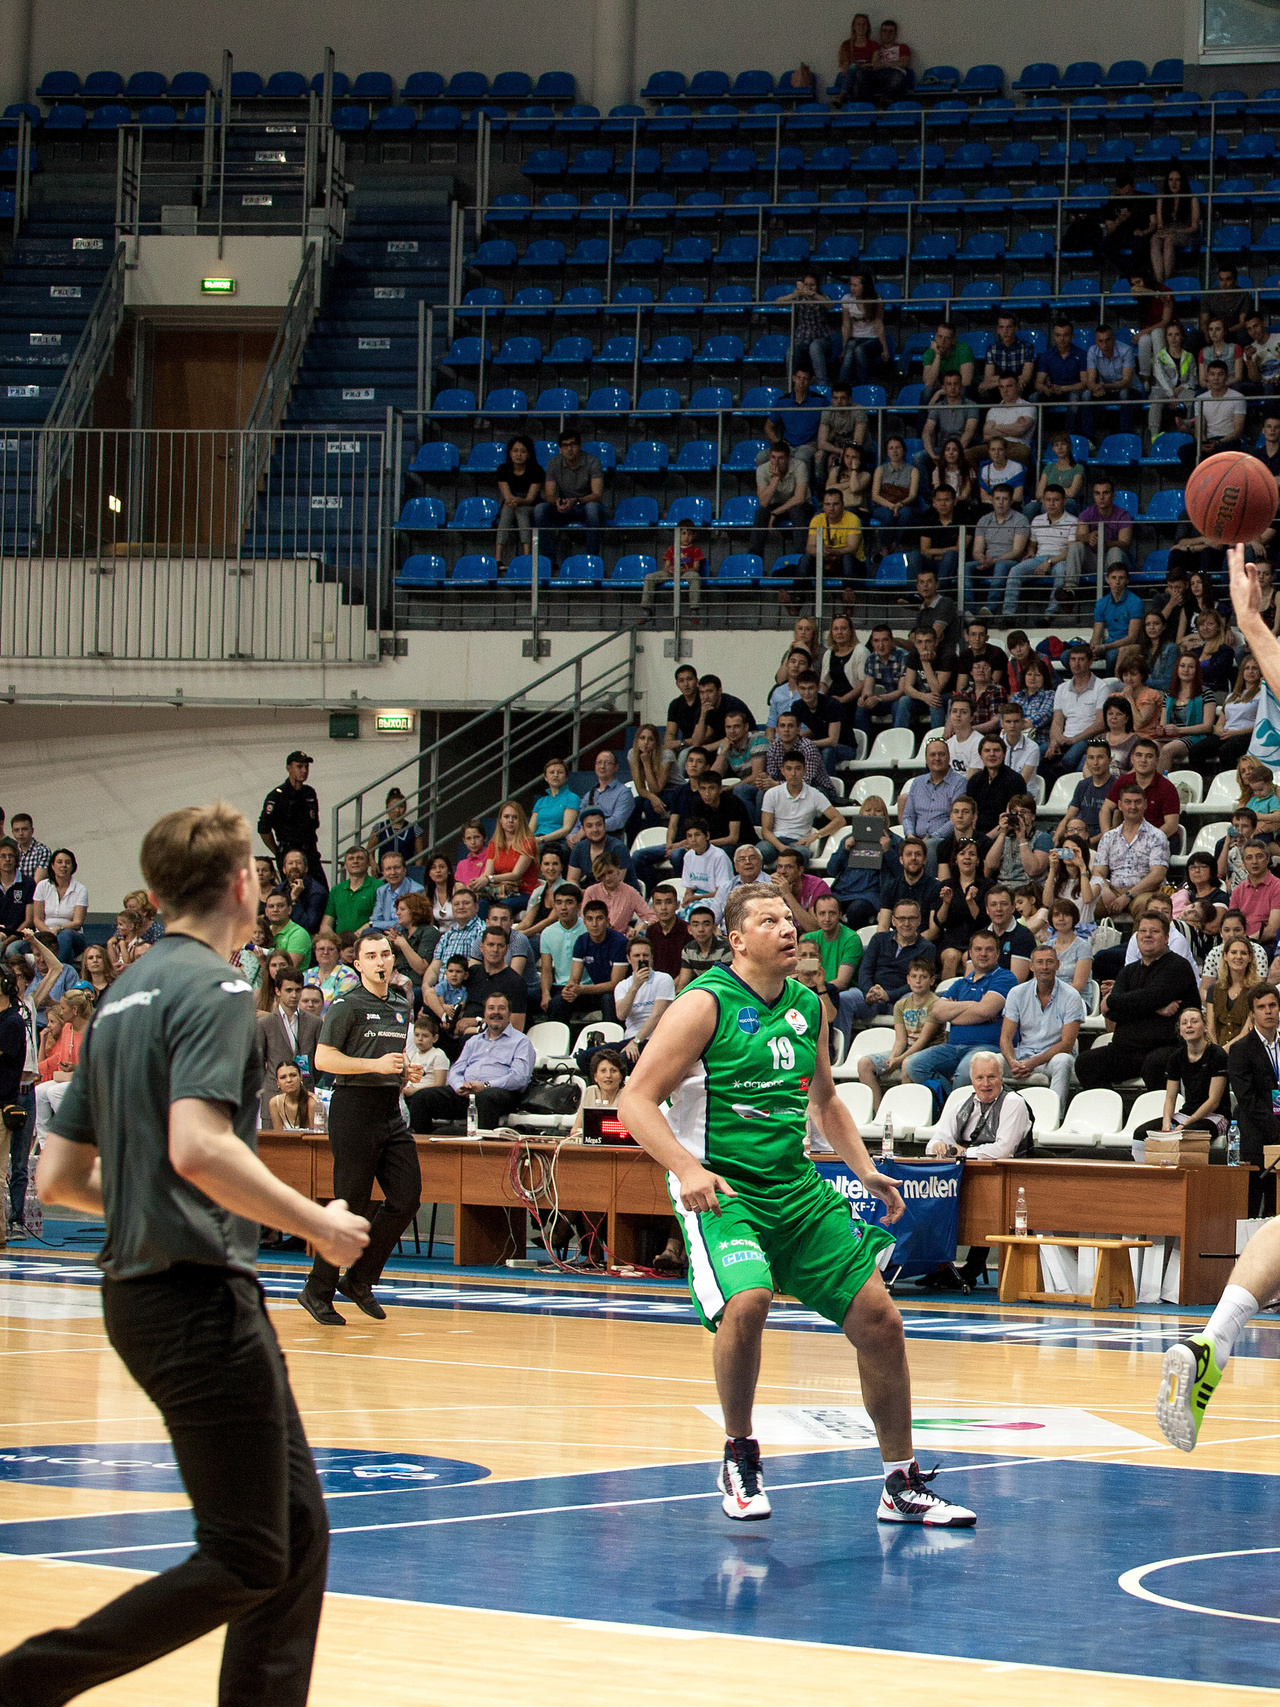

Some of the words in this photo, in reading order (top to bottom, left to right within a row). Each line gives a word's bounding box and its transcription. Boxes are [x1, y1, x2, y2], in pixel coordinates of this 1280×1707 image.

[1212, 487, 1240, 539] Wilson
[378, 718, 407, 729] ВЫХОД
[767, 1036, 796, 1070] 19
[903, 1177, 958, 1199] molten
